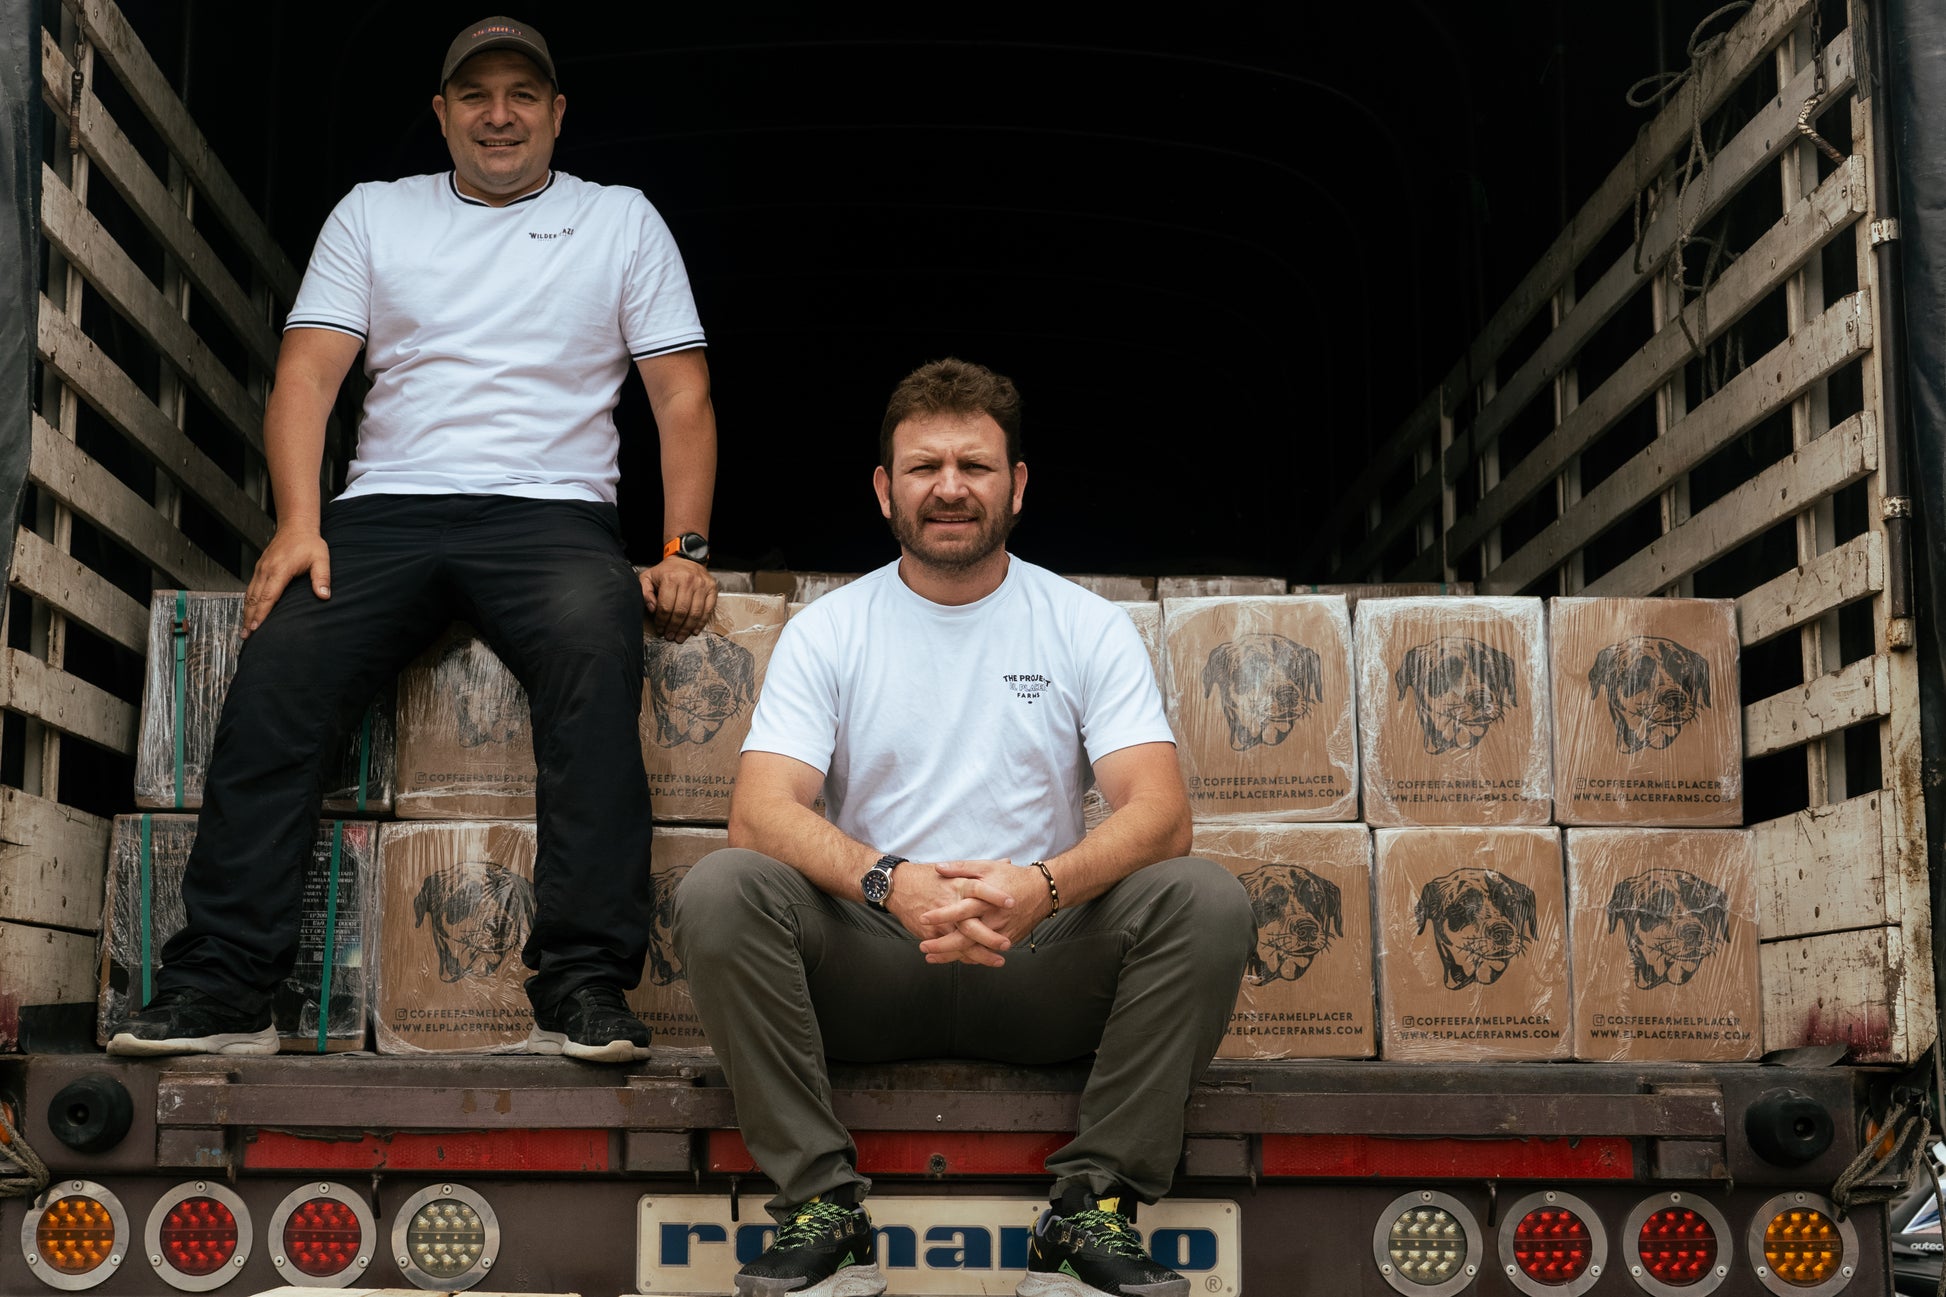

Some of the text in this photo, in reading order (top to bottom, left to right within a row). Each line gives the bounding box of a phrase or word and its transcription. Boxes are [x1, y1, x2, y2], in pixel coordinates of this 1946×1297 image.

[1003, 674, 1051, 687] THE PROJET
[1204, 775, 1334, 787] COFFEEFARMELPLACER
[1589, 779, 1721, 790] COFFEEFARMELPLACER
[1229, 1011, 1353, 1022] OFFEEFARMELPLACER
[1416, 1015, 1550, 1027] COFFEEFARMELPLACER
[1607, 1015, 1740, 1027] COFFEEFARMELPLACER
[392, 1022, 533, 1033] WWW.ELPLACERFARMS.C
[1401, 1029, 1560, 1040] WWW.ELPLACERFARMS.COM
